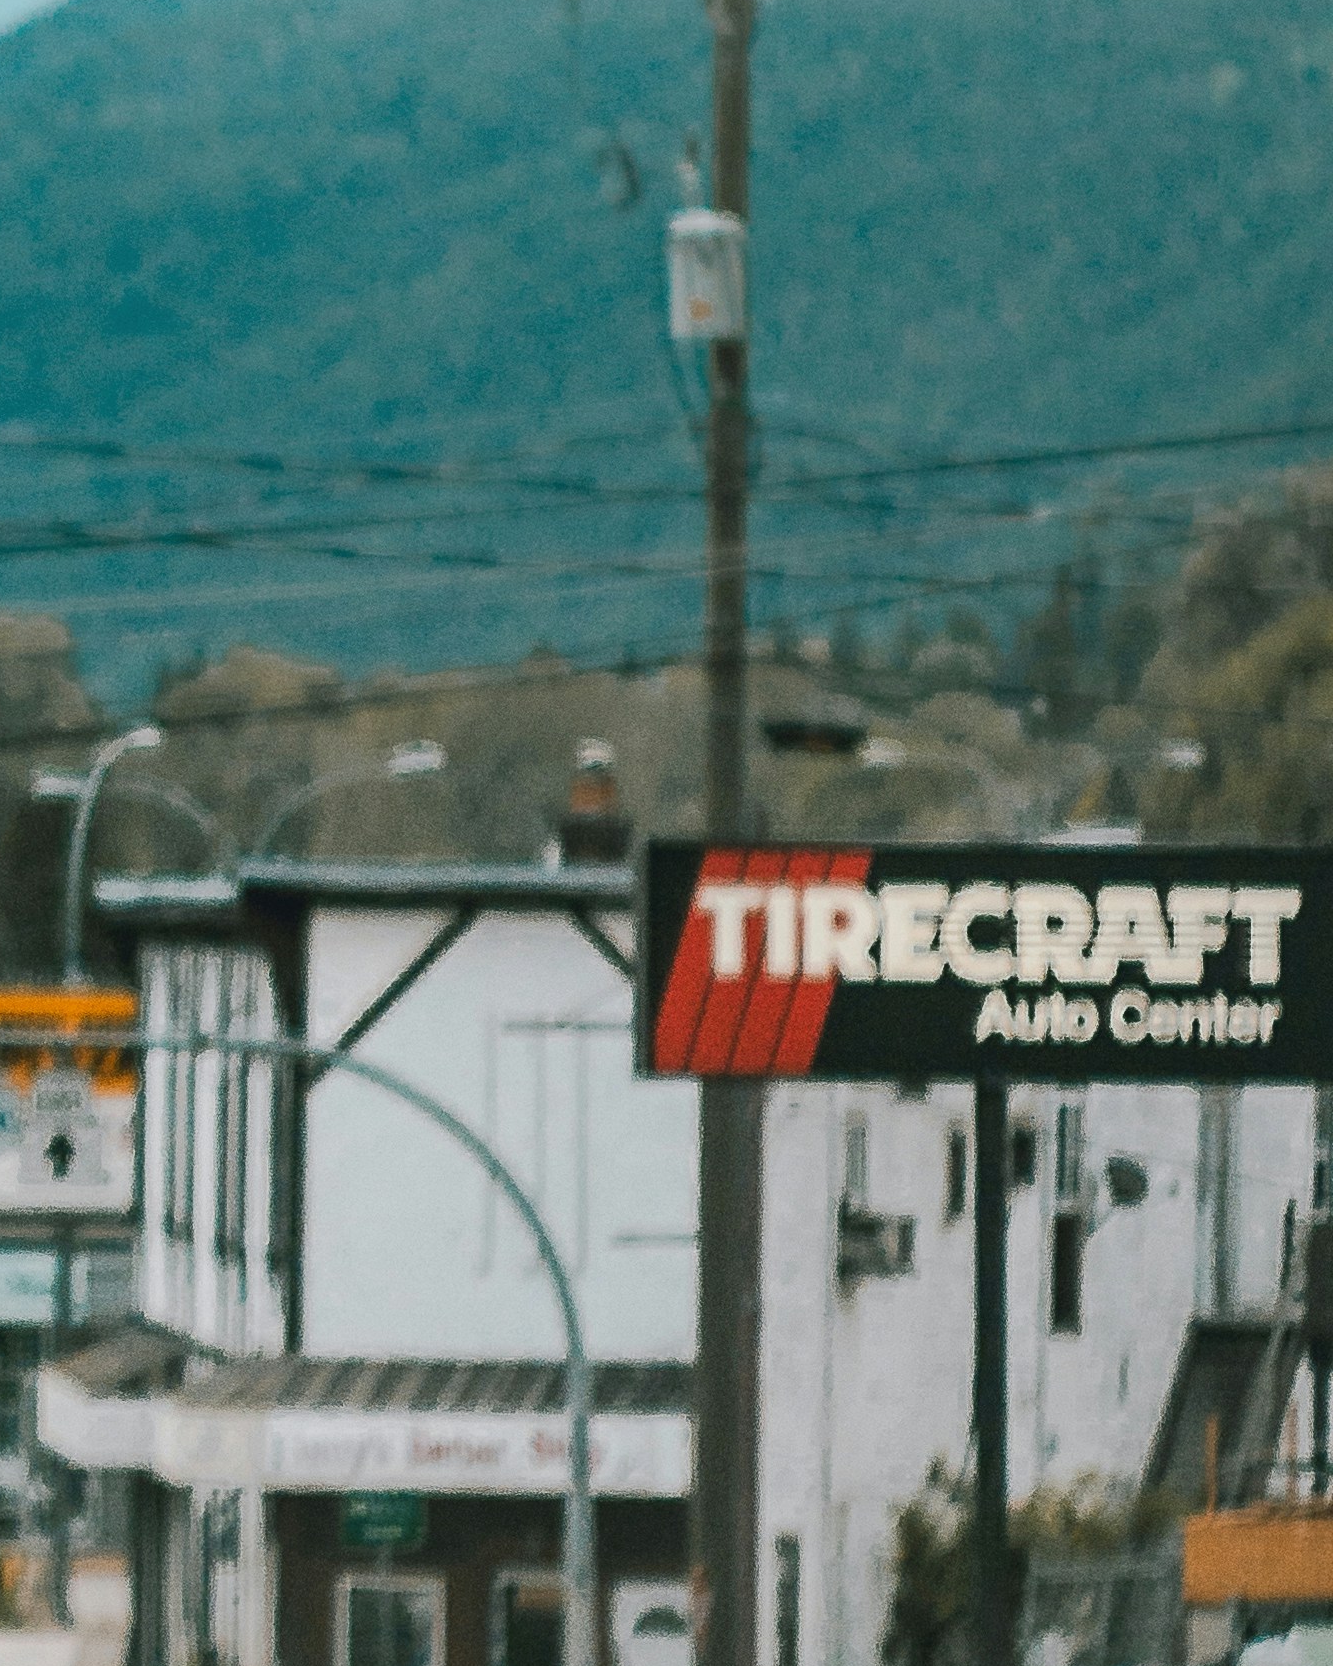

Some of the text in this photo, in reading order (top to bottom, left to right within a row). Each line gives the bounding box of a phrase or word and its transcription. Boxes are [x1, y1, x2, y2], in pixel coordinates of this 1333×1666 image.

[697, 882, 1301, 986] TIRECRAFT
[975, 987, 1282, 1045] Auto Center
